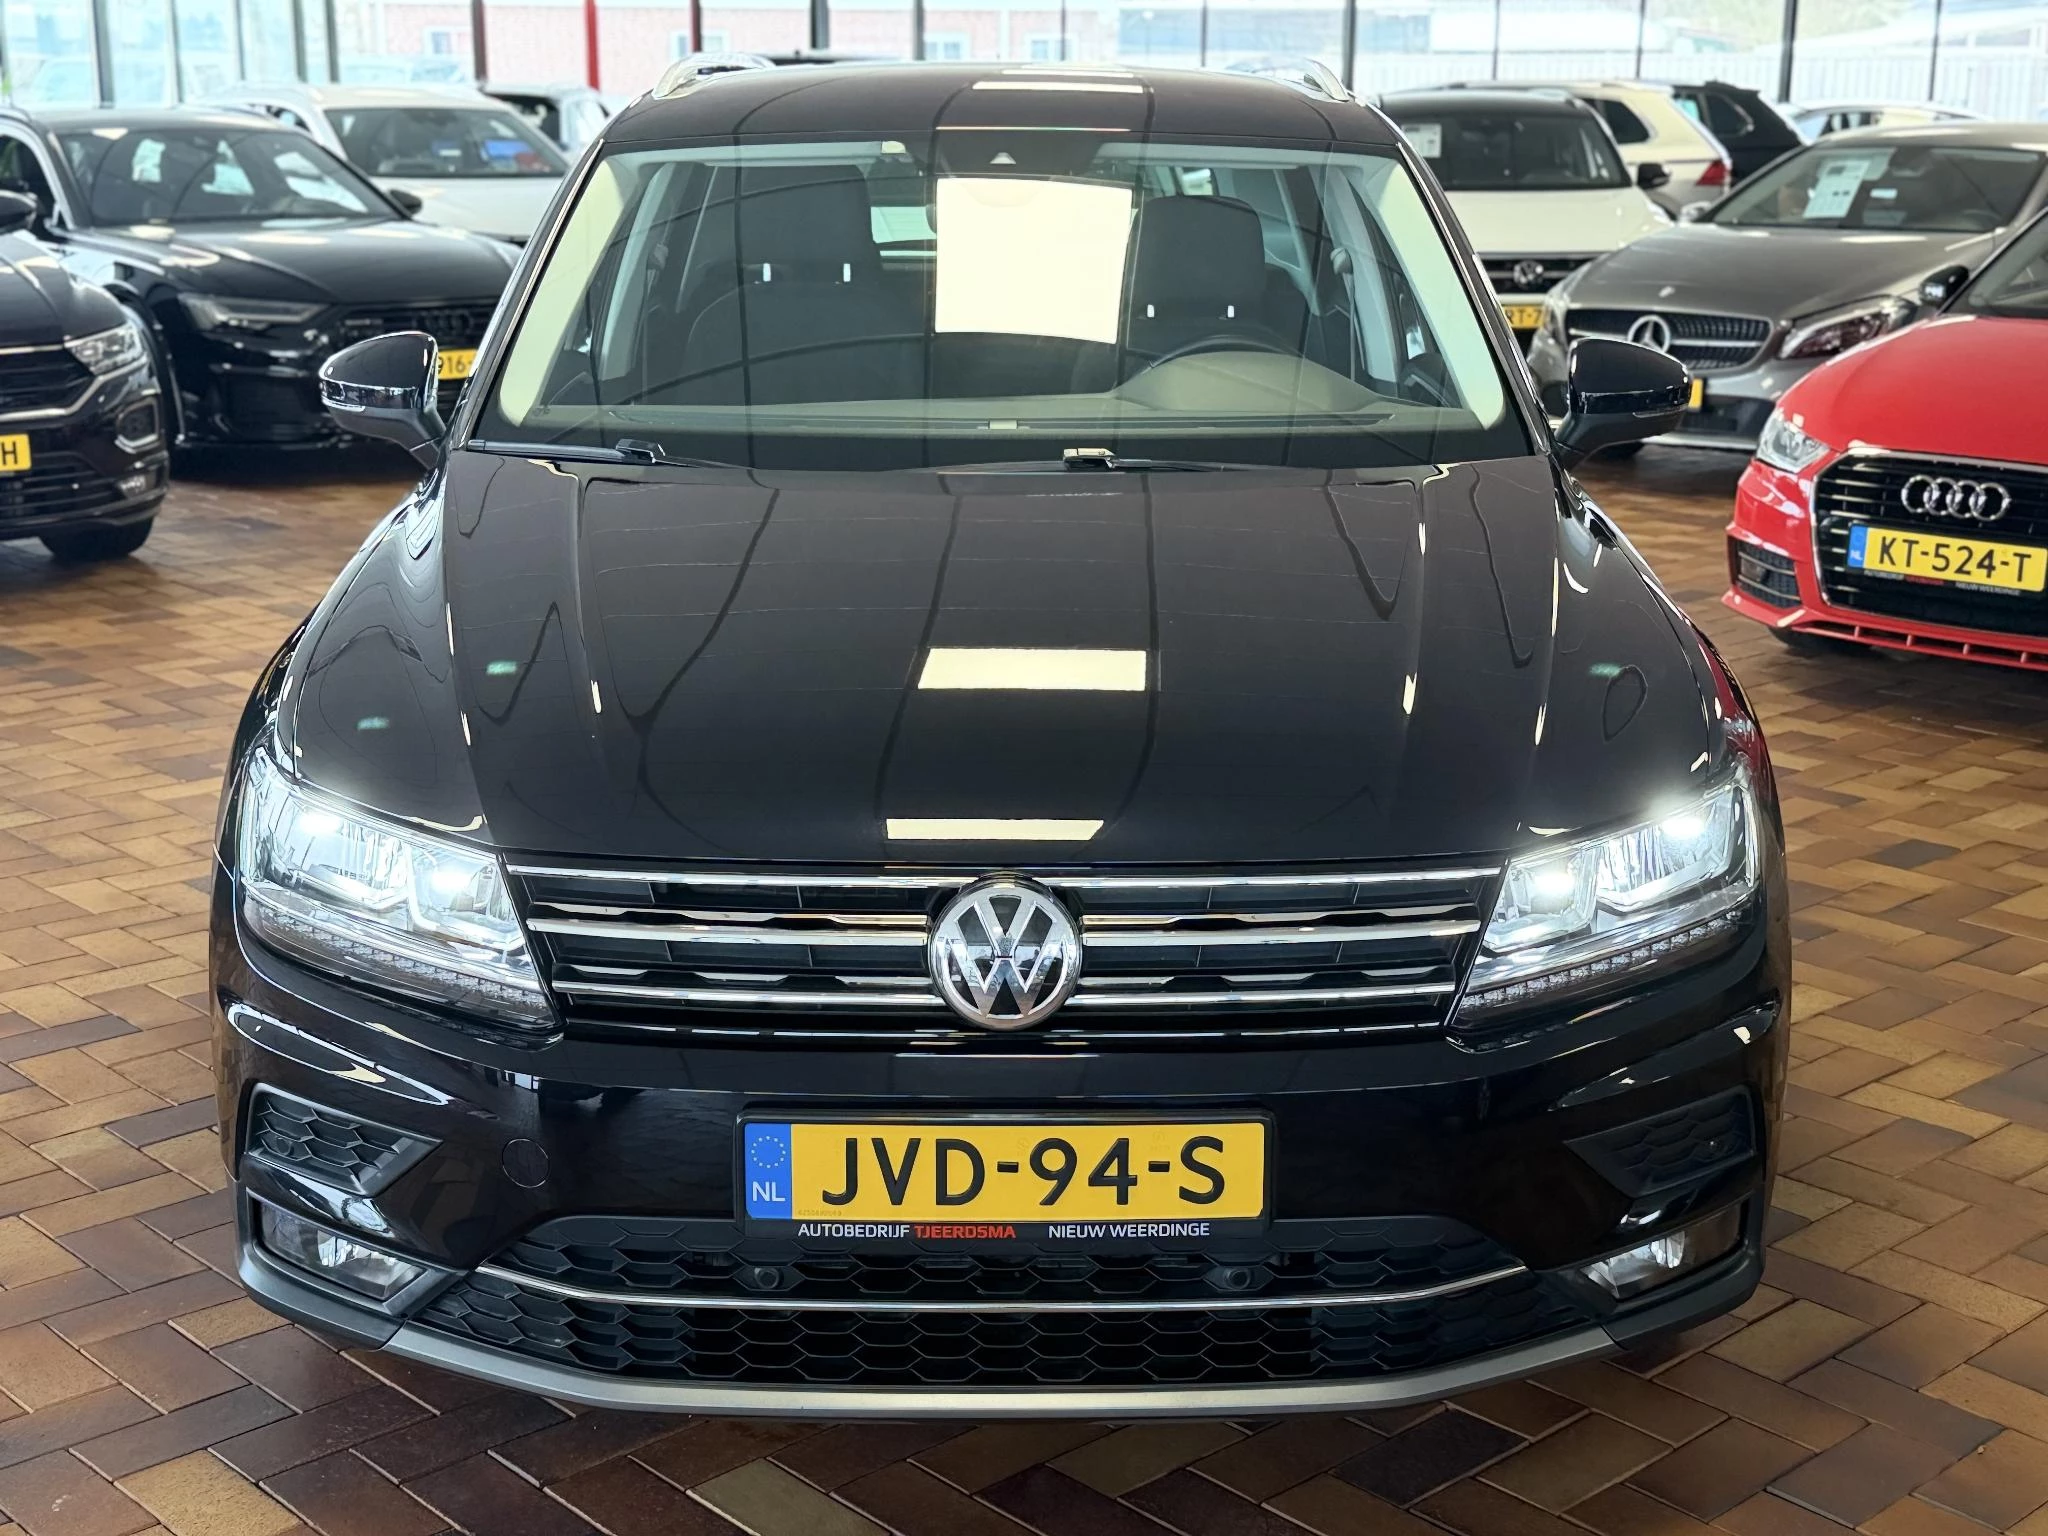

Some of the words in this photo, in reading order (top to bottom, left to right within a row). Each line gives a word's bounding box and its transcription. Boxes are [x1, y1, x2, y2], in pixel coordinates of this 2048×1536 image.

[1879, 535, 2032, 583] KT-524-T
[821, 1135, 1226, 1206] JVD-94-S
[752, 1181, 786, 1202] NL
[797, 1223, 911, 1238] AUTOBEDRIJF
[914, 1224, 1017, 1239] TJEERDSMA
[1048, 1224, 1107, 1239] NIEUW
[1109, 1222, 1211, 1238] WEERDINGE
